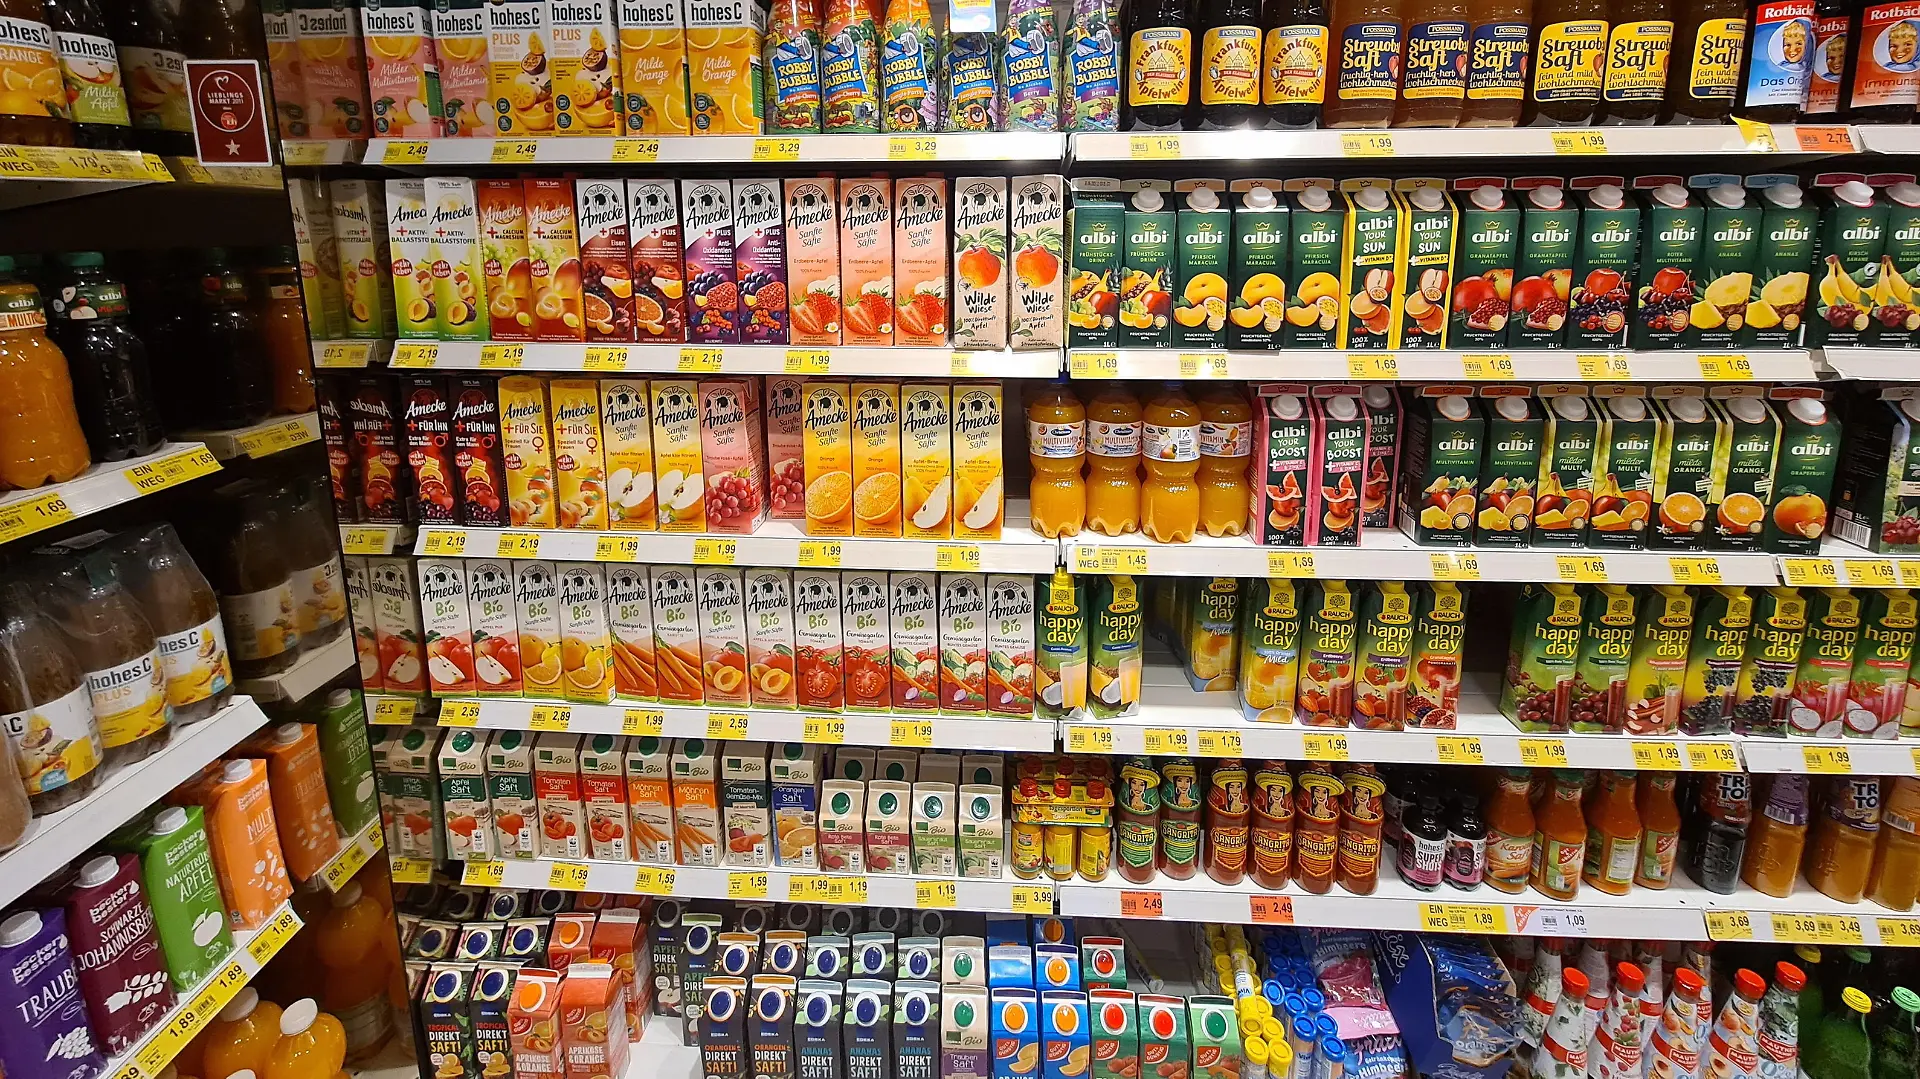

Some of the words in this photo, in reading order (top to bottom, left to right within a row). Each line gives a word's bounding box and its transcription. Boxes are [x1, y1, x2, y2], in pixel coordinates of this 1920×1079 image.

[492, 33, 520, 45] PLUS
[553, 28, 581, 41] PLUS
[1136, 39, 1185, 67] Frankfurter
[1274, 37, 1323, 67] Frankfurter
[636, 57, 664, 72] Milde
[885, 59, 918, 73] ROBBY
[1010, 54, 1044, 70] ROBBY
[381, 63, 409, 76] Milder
[779, 62, 812, 76] ROBBY
[373, 74, 420, 88] Multivitamin
[635, 69, 669, 84] Orange
[780, 72, 818, 89] BUBBLE
[886, 68, 923, 88] BUBBLE
[1009, 66, 1050, 86] BUBBLE
[1761, 77, 1784, 86] Das
[1136, 79, 1184, 99] Apfelwein
[1274, 78, 1322, 98] Apfelwein
[90, 97, 120, 111] Apfel
[1370, 138, 1392, 148] 1,99
[1581, 136, 1604, 146] 1,99
[1827, 133, 1850, 144] 2,79
[517, 144, 537, 154] 2,49
[638, 144, 659, 153] 2,49
[779, 143, 800, 152] 3,29
[915, 141, 936, 151] 3,29
[1158, 140, 1180, 150] 1,99
[957, 206, 1005, 229] Amecke
[798, 227, 823, 239] Sanfte
[1364, 230, 1386, 241] YOUR
[1532, 231, 1569, 243] albi
[1843, 227, 1880, 240] albi
[802, 236, 822, 248] Säfte
[1363, 240, 1386, 254] SUN
[964, 292, 997, 305] Wilde
[1021, 292, 1054, 304] Wilde
[969, 303, 992, 313] Wiese
[1026, 303, 1049, 313] Wiese
[8, 312, 36, 328] MULTI
[972, 321, 989, 330] Apfel
[504, 348, 523, 358] 2,19
[702, 353, 722, 364] 2,19
[815, 428, 838, 439] Sanfte
[819, 436, 837, 447] Säfte
[1042, 437, 1083, 445] MULTIVITAMIN
[1278, 437, 1299, 447] YOUR
[1439, 439, 1475, 451] albi
[1271, 447, 1306, 458] BOOST
[1791, 443, 1831, 456] albi
[1559, 456, 1586, 465] milder
[1679, 459, 1702, 467] milde
[132, 464, 153, 477] EIN
[136, 475, 165, 491] WEG
[520, 538, 539, 548] 2,19
[1081, 548, 1096, 556] EIN
[1079, 559, 1099, 568] WEG
[1127, 555, 1146, 565] 1,45
[1584, 561, 1605, 572] 1,69
[1697, 563, 1719, 574] 1,69
[1872, 565, 1894, 576] 1,69
[423, 582, 463, 602] Amecke
[435, 600, 455, 617] Bio
[796, 596, 838, 617] Amecke
[1053, 605, 1075, 613] RAUCH
[808, 613, 829, 629] Bio
[1040, 610, 1084, 633] happy
[1047, 628, 1077, 647] day
[1546, 642, 1577, 658] day
[1765, 643, 1800, 661] day
[1264, 653, 1289, 665] Mild
[461, 707, 479, 717] 2,59
[552, 711, 570, 721] 2,89
[729, 718, 748, 729] 2,59
[1222, 735, 1241, 746] 1,79
[542, 777, 571, 786] Tomaten
[450, 784, 471, 794] Saft
[632, 783, 663, 793] Möhren
[778, 785, 805, 794] Orangen
[781, 792, 802, 803] Saft
[1119, 826, 1155, 842] SANGRITA
[1252, 835, 1291, 848] SANGRITA
[1417, 852, 1442, 862] SUPER
[1416, 861, 1442, 871] SHOTS
[571, 869, 588, 880] 1,59
[849, 881, 867, 891] 1,19
[1033, 891, 1052, 903] 3,99
[1143, 898, 1162, 910] 2,49
[1429, 905, 1443, 914] EIN
[99, 900, 144, 942] SCHWARZE
[272, 912, 294, 935] 1,89
[1428, 918, 1448, 927] WEG
[1474, 913, 1493, 924] 1,89
[1566, 915, 1585, 926] 1,09
[1730, 916, 1749, 927] 3,69
[1840, 921, 1860, 933] 3,49
[169, 1011, 196, 1038] 1,89
[428, 1031, 461, 1041] DIREKT
[430, 1040, 462, 1052] SAFT!
[568, 1047, 603, 1056] APRIKOSE
[801, 1047, 832, 1055] ANANAS
[705, 1051, 737, 1061] DIREKT
[801, 1056, 833, 1067] DIREKT
[706, 1061, 737, 1073] SAFT!
[953, 1060, 975, 1069] Saft
[802, 1066, 833, 1079] SAFT!
